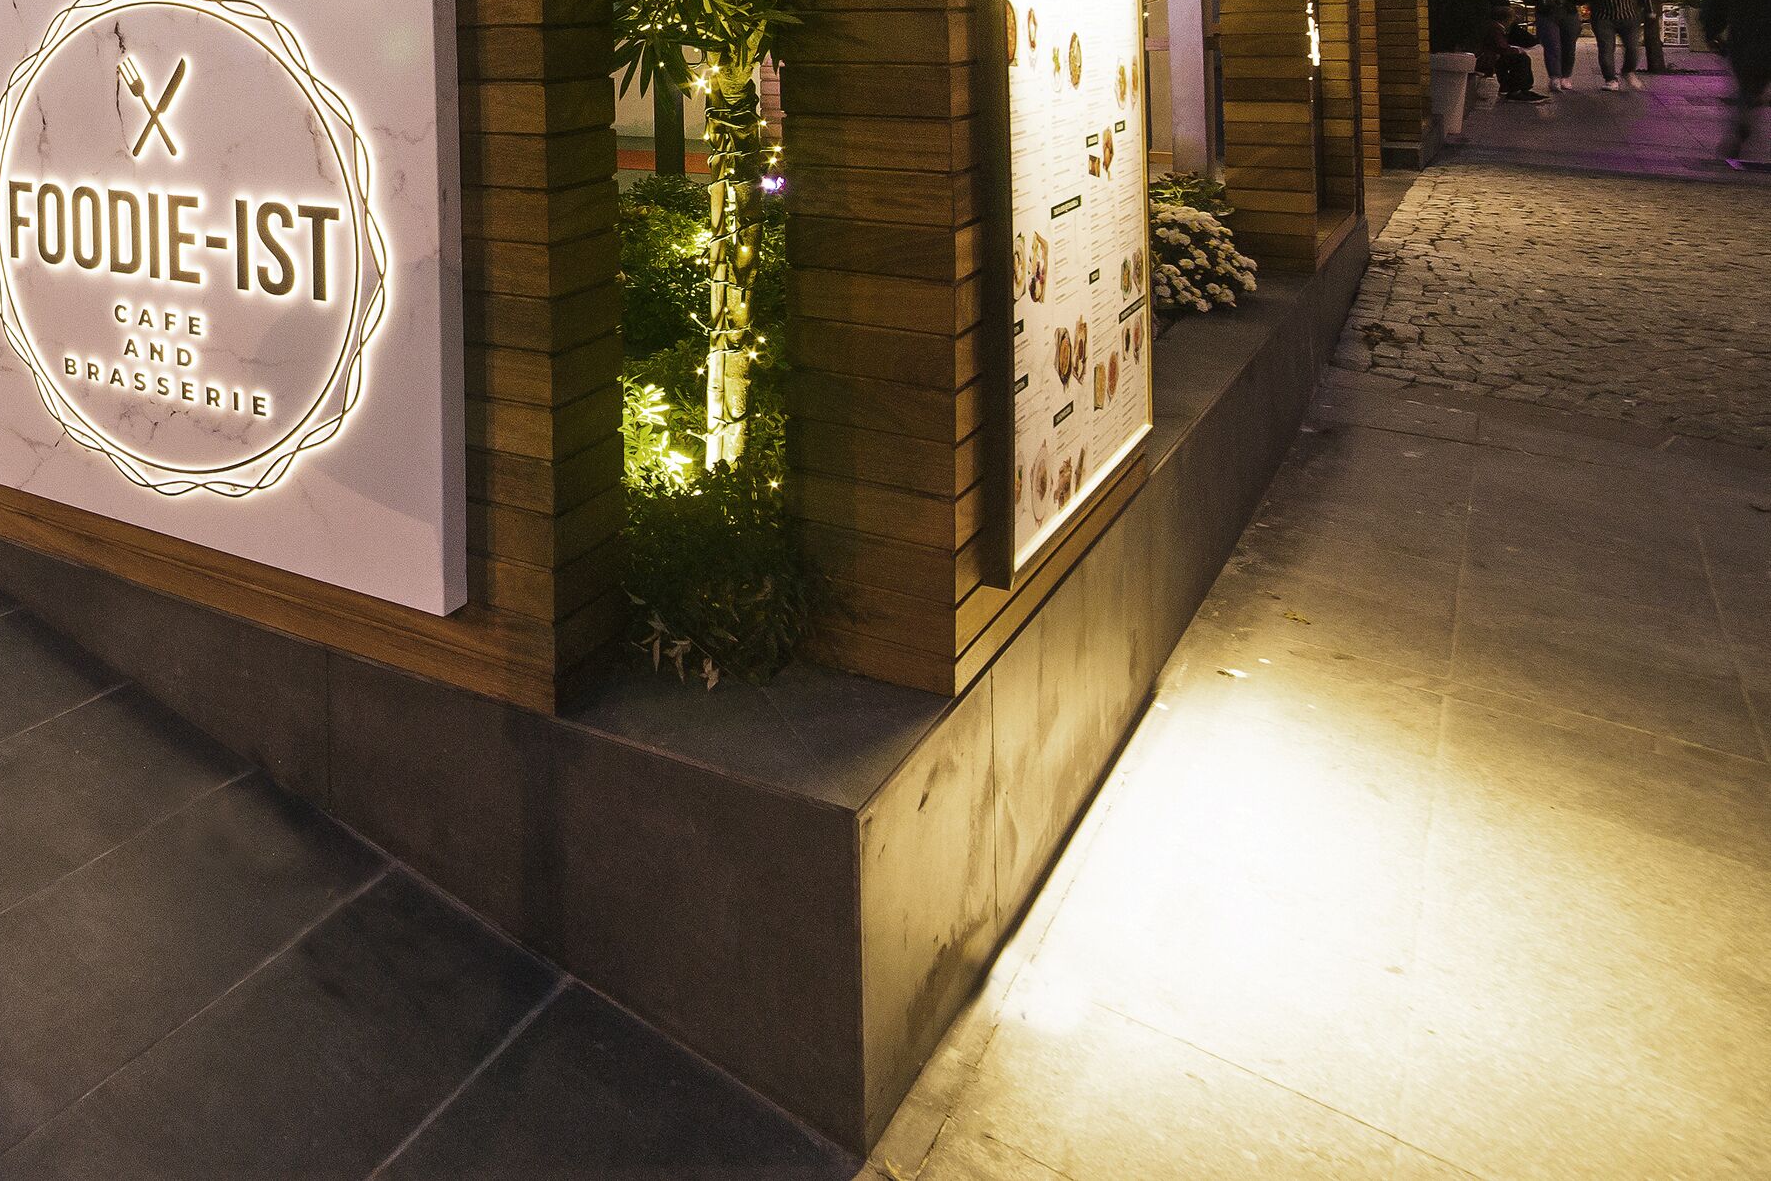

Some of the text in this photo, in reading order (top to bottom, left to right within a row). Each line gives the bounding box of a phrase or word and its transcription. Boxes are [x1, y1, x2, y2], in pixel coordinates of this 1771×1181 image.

[8, 179, 340, 302] FOODIE-IST
[113, 303, 202, 336] CAFE
[122, 338, 193, 368] AND
[63, 356, 268, 418] BRASSERIE
